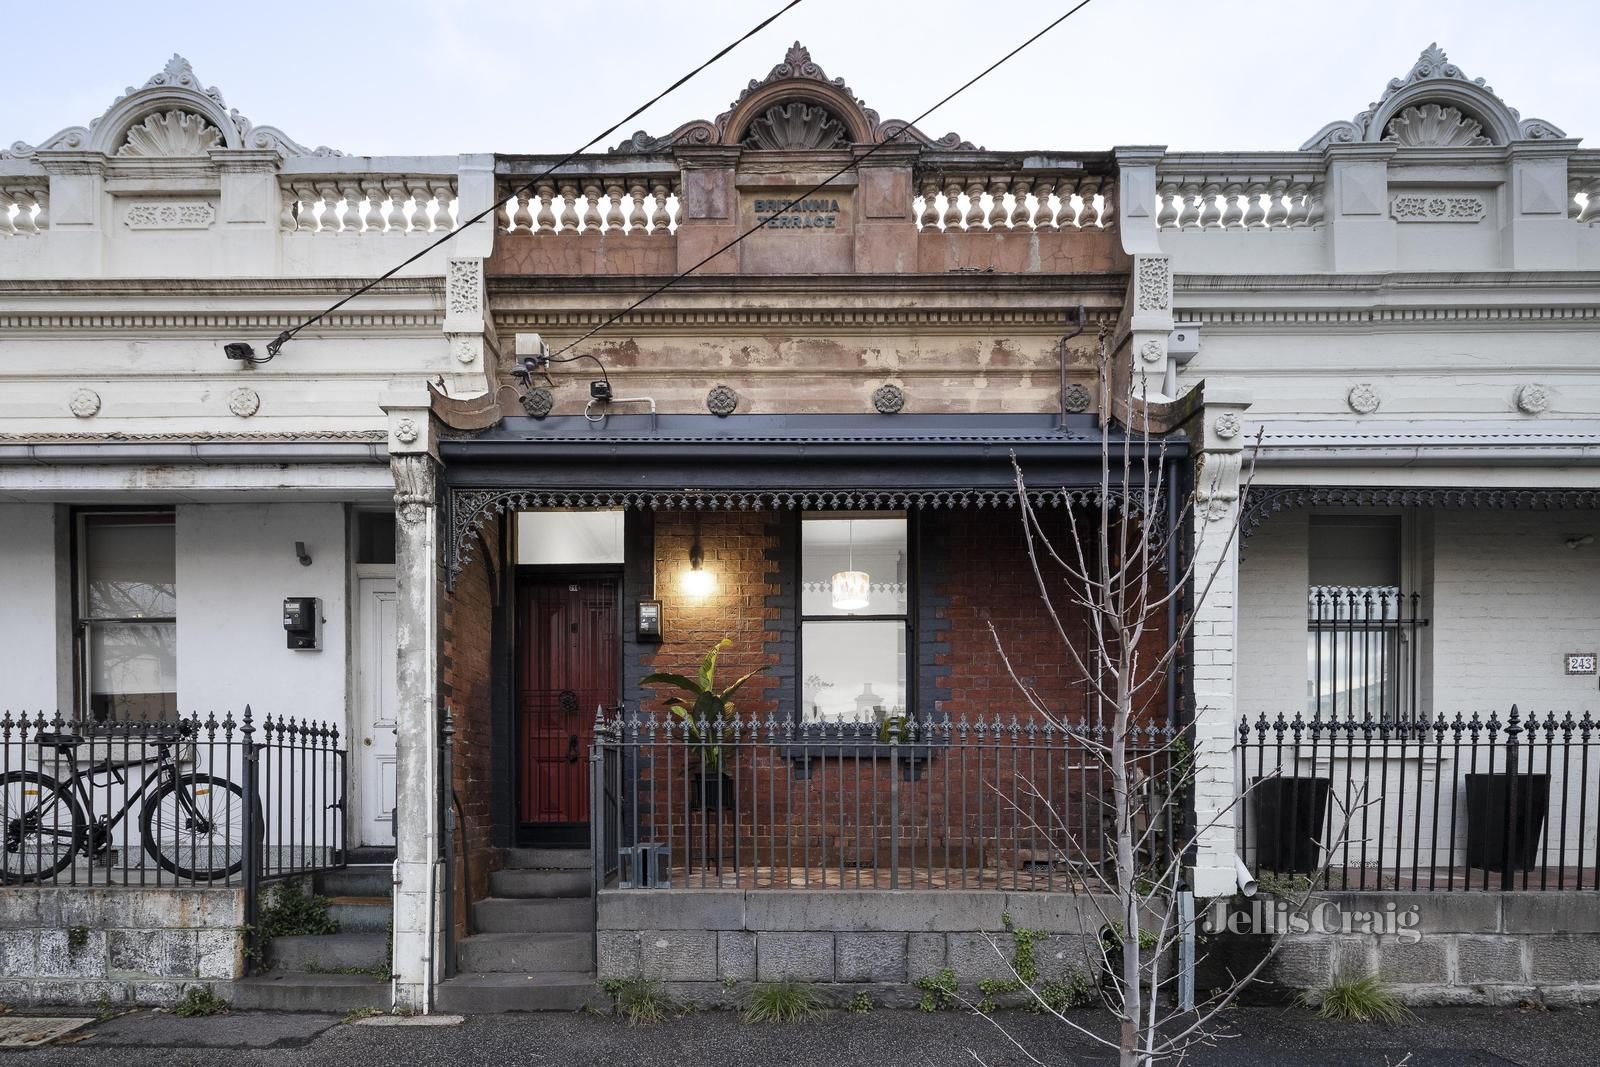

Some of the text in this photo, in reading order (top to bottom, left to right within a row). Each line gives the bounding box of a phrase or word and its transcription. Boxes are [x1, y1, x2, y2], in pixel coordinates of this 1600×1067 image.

[754, 199, 840, 213] BRITANNIA
[757, 215, 836, 229] TERRACE
[1571, 658, 1592, 670] 243
